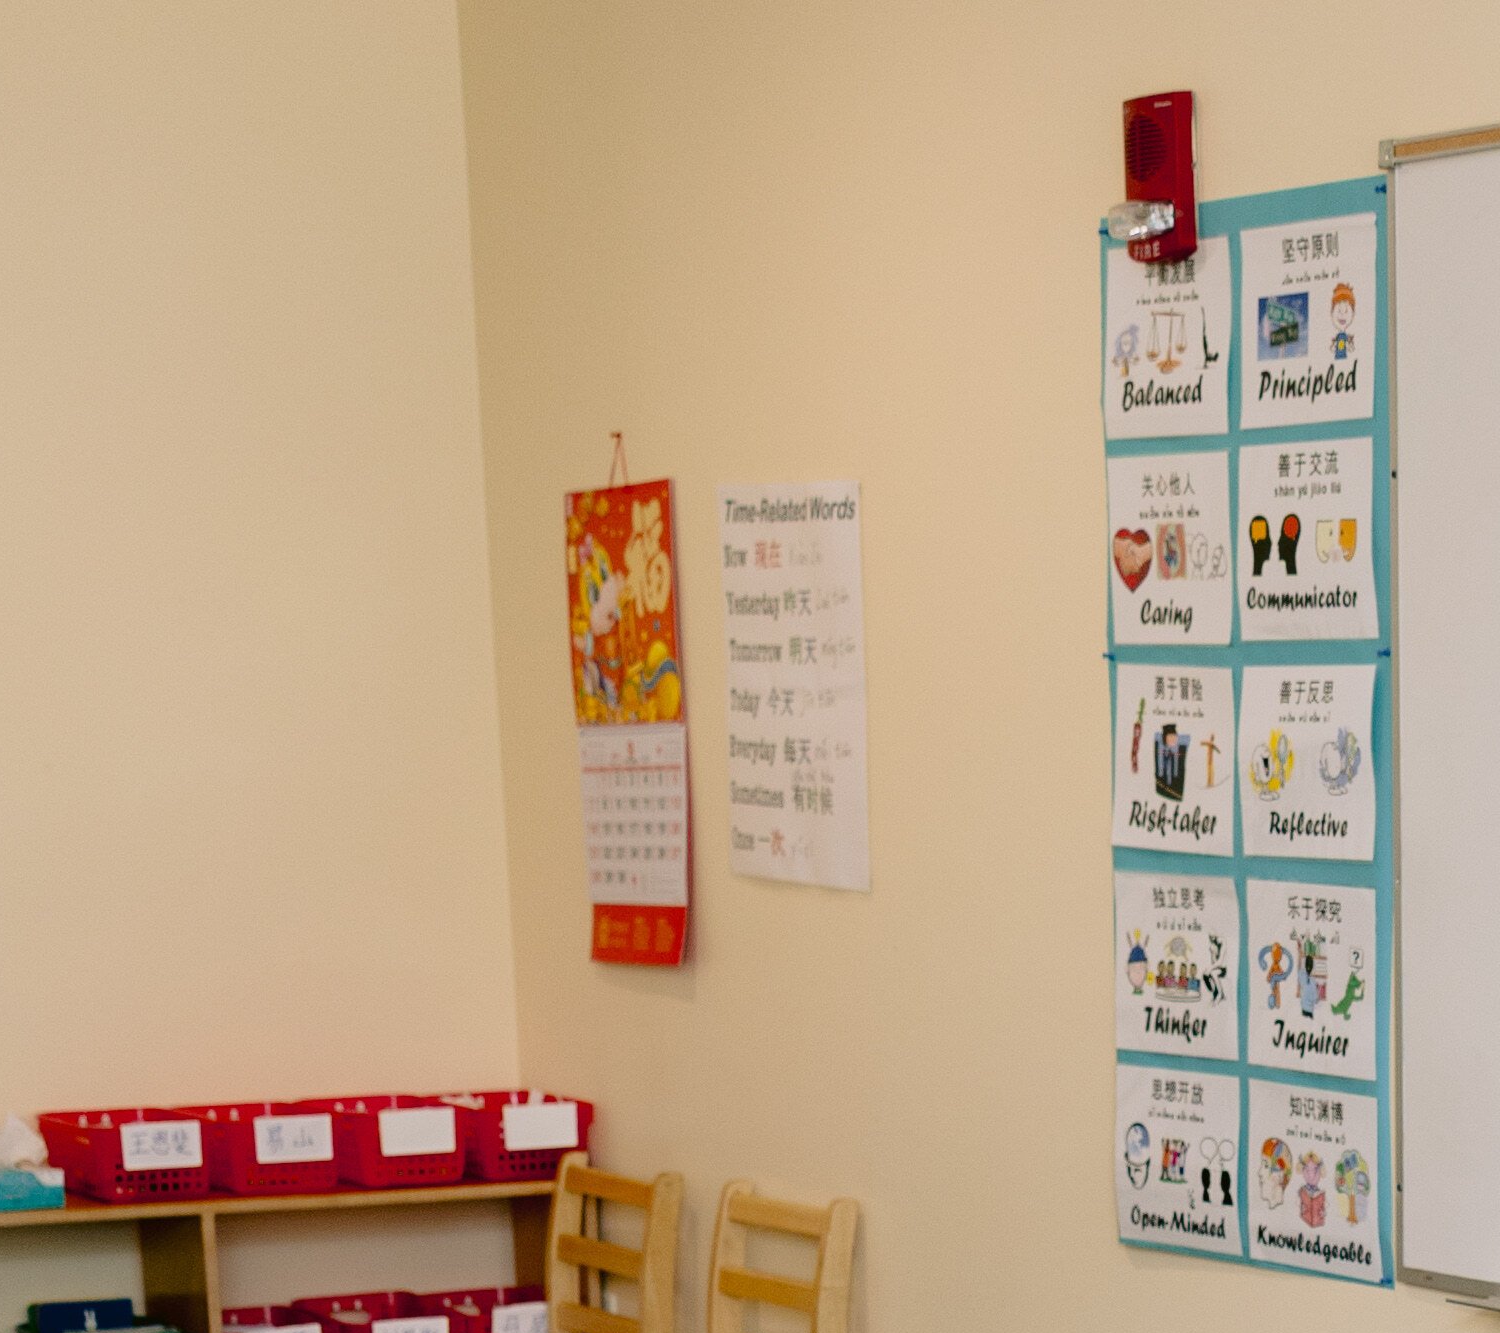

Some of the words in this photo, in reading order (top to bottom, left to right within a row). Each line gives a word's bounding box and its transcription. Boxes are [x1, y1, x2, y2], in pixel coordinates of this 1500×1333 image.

[1134, 242, 1162, 260] FIRE
[1122, 376, 1203, 413] Balanced
[1259, 360, 1358, 405] Principled
[1278, 450, 1340, 476] 善于交流
[810, 496, 855, 520] Words
[1246, 584, 1358, 610] Communicator
[1141, 599, 1193, 633] Caring
[1279, 680, 1334, 705] 善于反思
[1129, 801, 1218, 840] Risk-taker
[1268, 811, 1348, 841] Reflective
[1288, 896, 1342, 923] 乐于探究
[1144, 1007, 1208, 1044] Thinker
[1272, 1019, 1350, 1058] Inquirer
[1151, 1079, 1204, 1106] 思想开放
[1289, 1095, 1345, 1126] 知识渊博
[1130, 1204, 1226, 1240] Open-Minded
[1257, 1224, 1372, 1266] Knowledgeable
